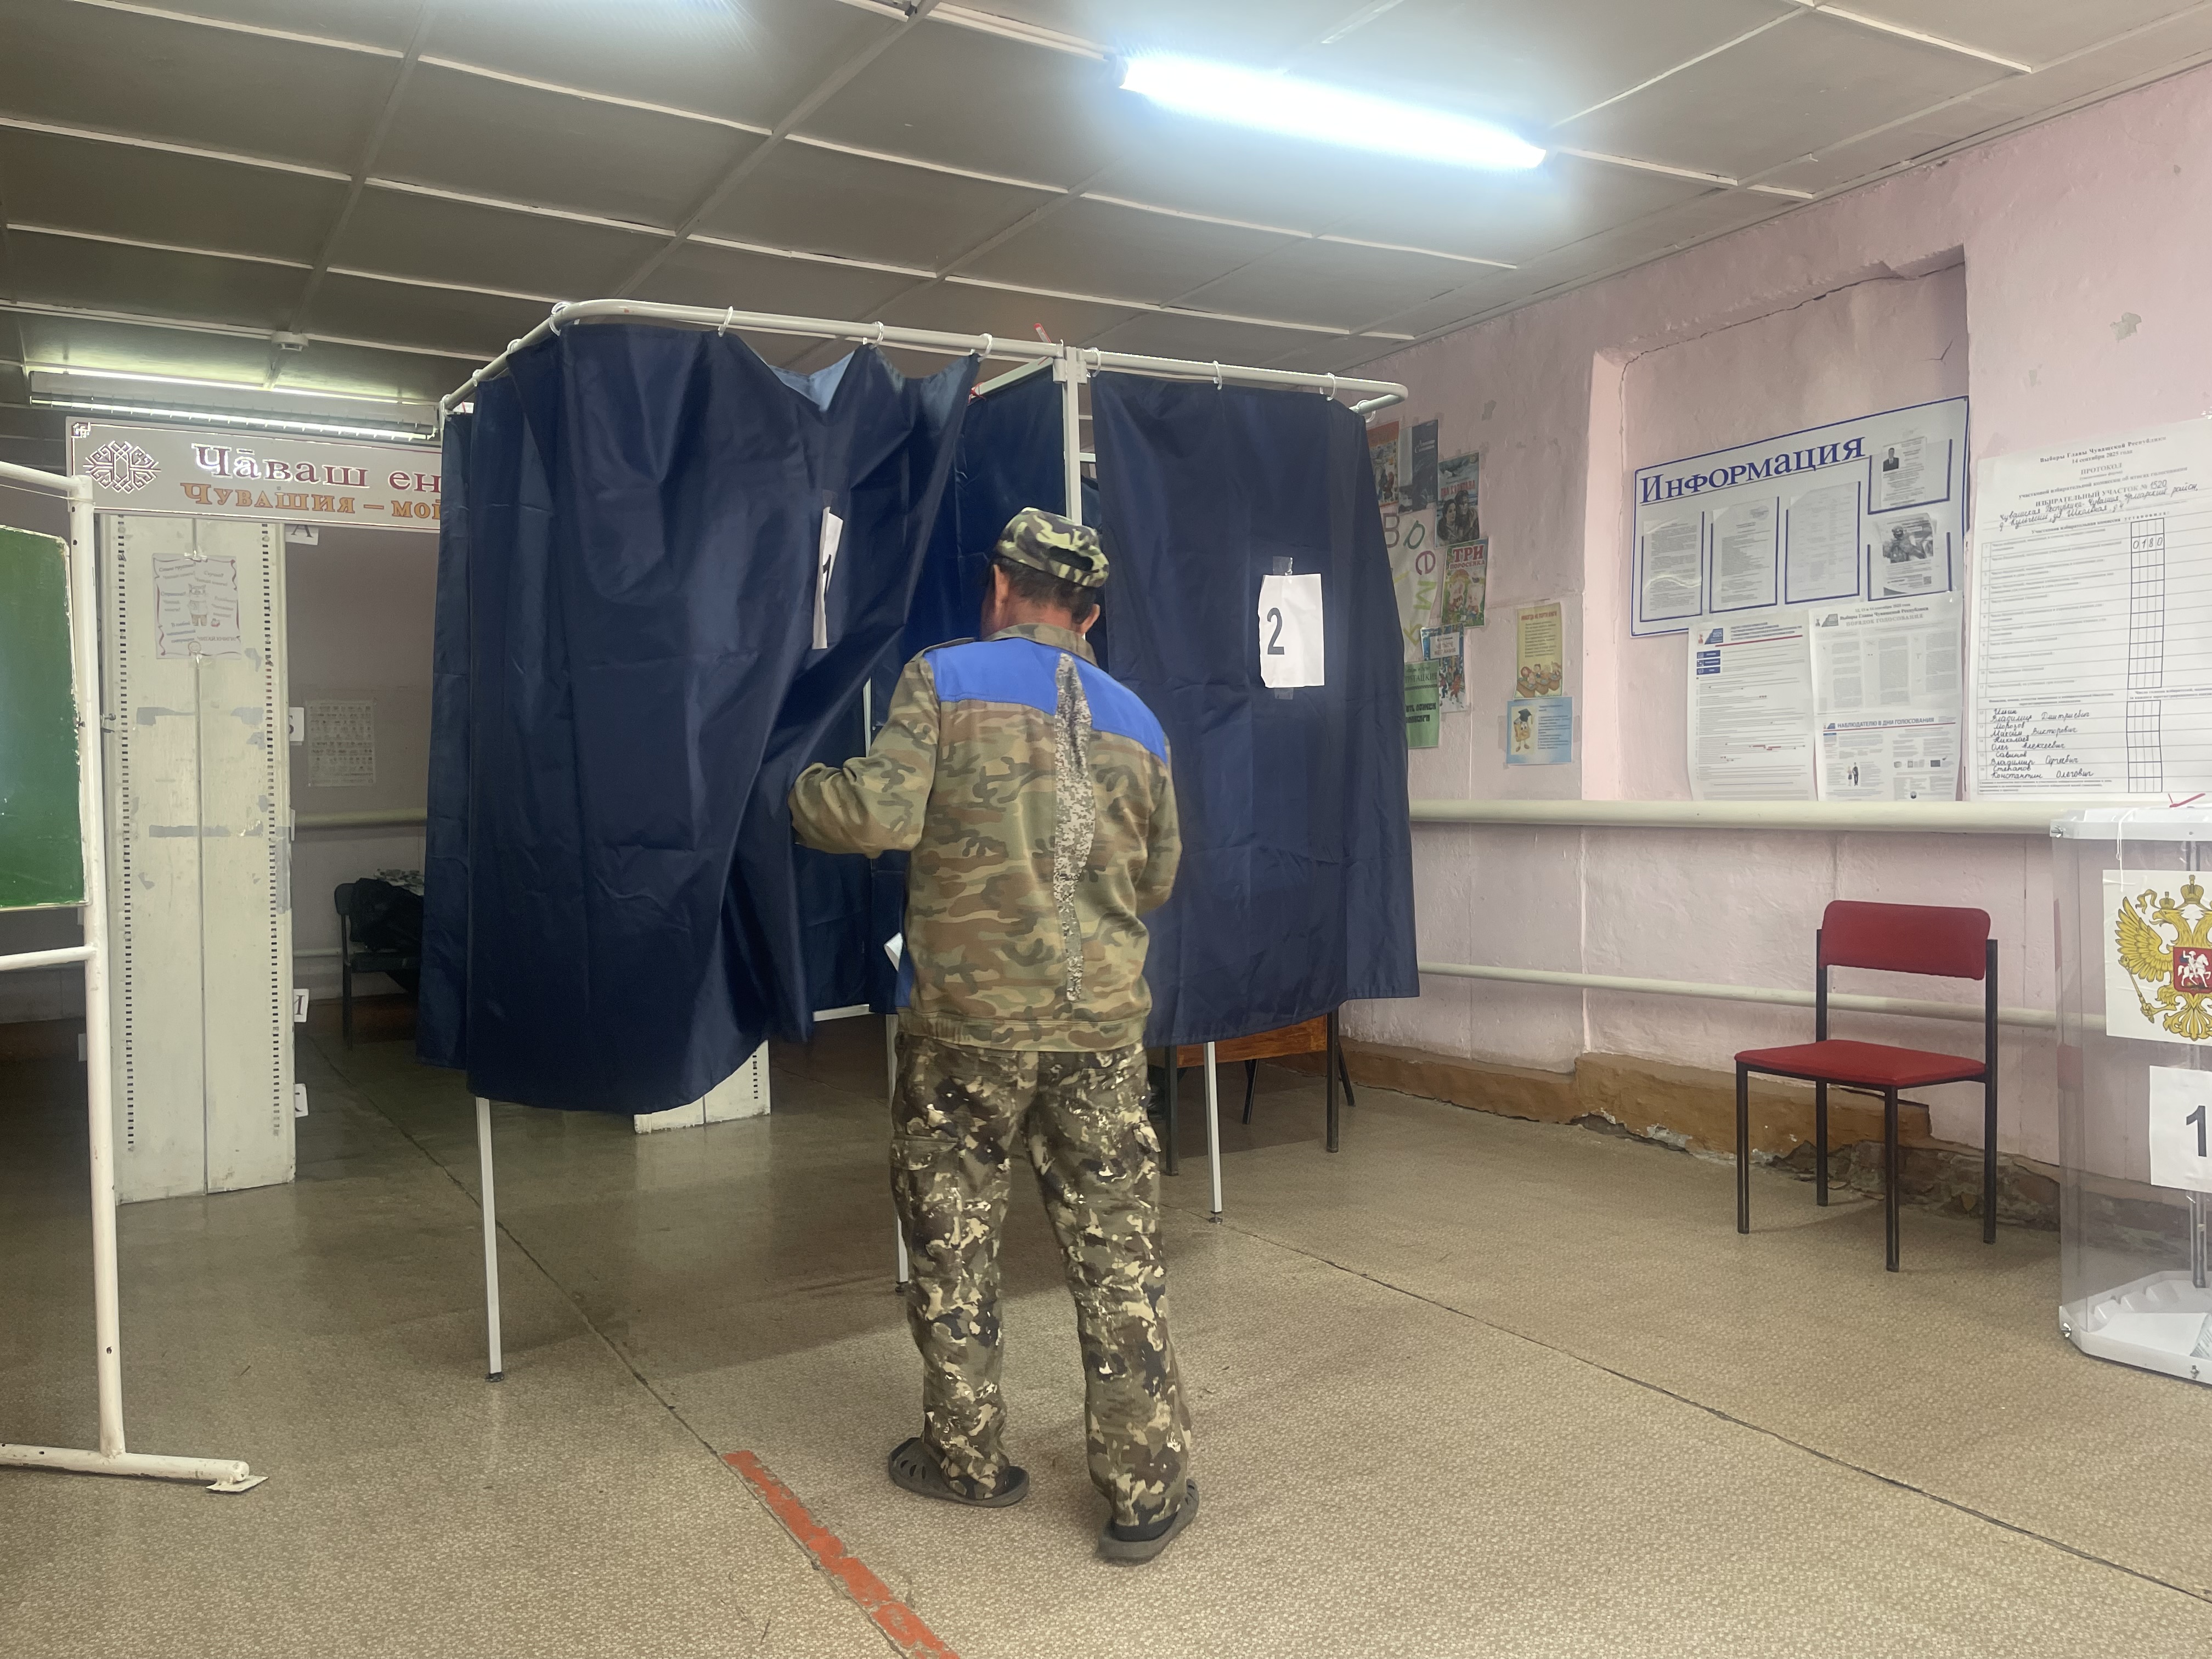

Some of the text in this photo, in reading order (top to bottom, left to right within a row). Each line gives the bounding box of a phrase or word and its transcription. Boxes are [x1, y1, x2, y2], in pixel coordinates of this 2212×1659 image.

[1640, 437, 1865, 504] Информация
[2081, 462, 2122, 475] ПРОТОКОЛ
[2035, 490, 2100, 507] ИЗБИРАТЕЛЬНЫЙ
[2102, 484, 2138, 496] УЧАСТОК
[2150, 479, 2167, 489] 1520
[1452, 545, 1484, 563] ТРИ
[1267, 607, 1285, 655] 2
[1990, 709, 2090, 723] Владимир Дмитриевич
[1993, 721, 2025, 731] Морозов
[2031, 725, 2078, 738] Викторович
[1993, 735, 2029, 743] Николаев
[2022, 741, 2066, 749] Алексеевич
[1989, 758, 2035, 766] Владимир
[2056, 768, 2094, 778] Олегович
[2186, 1105, 2207, 1158] 1
